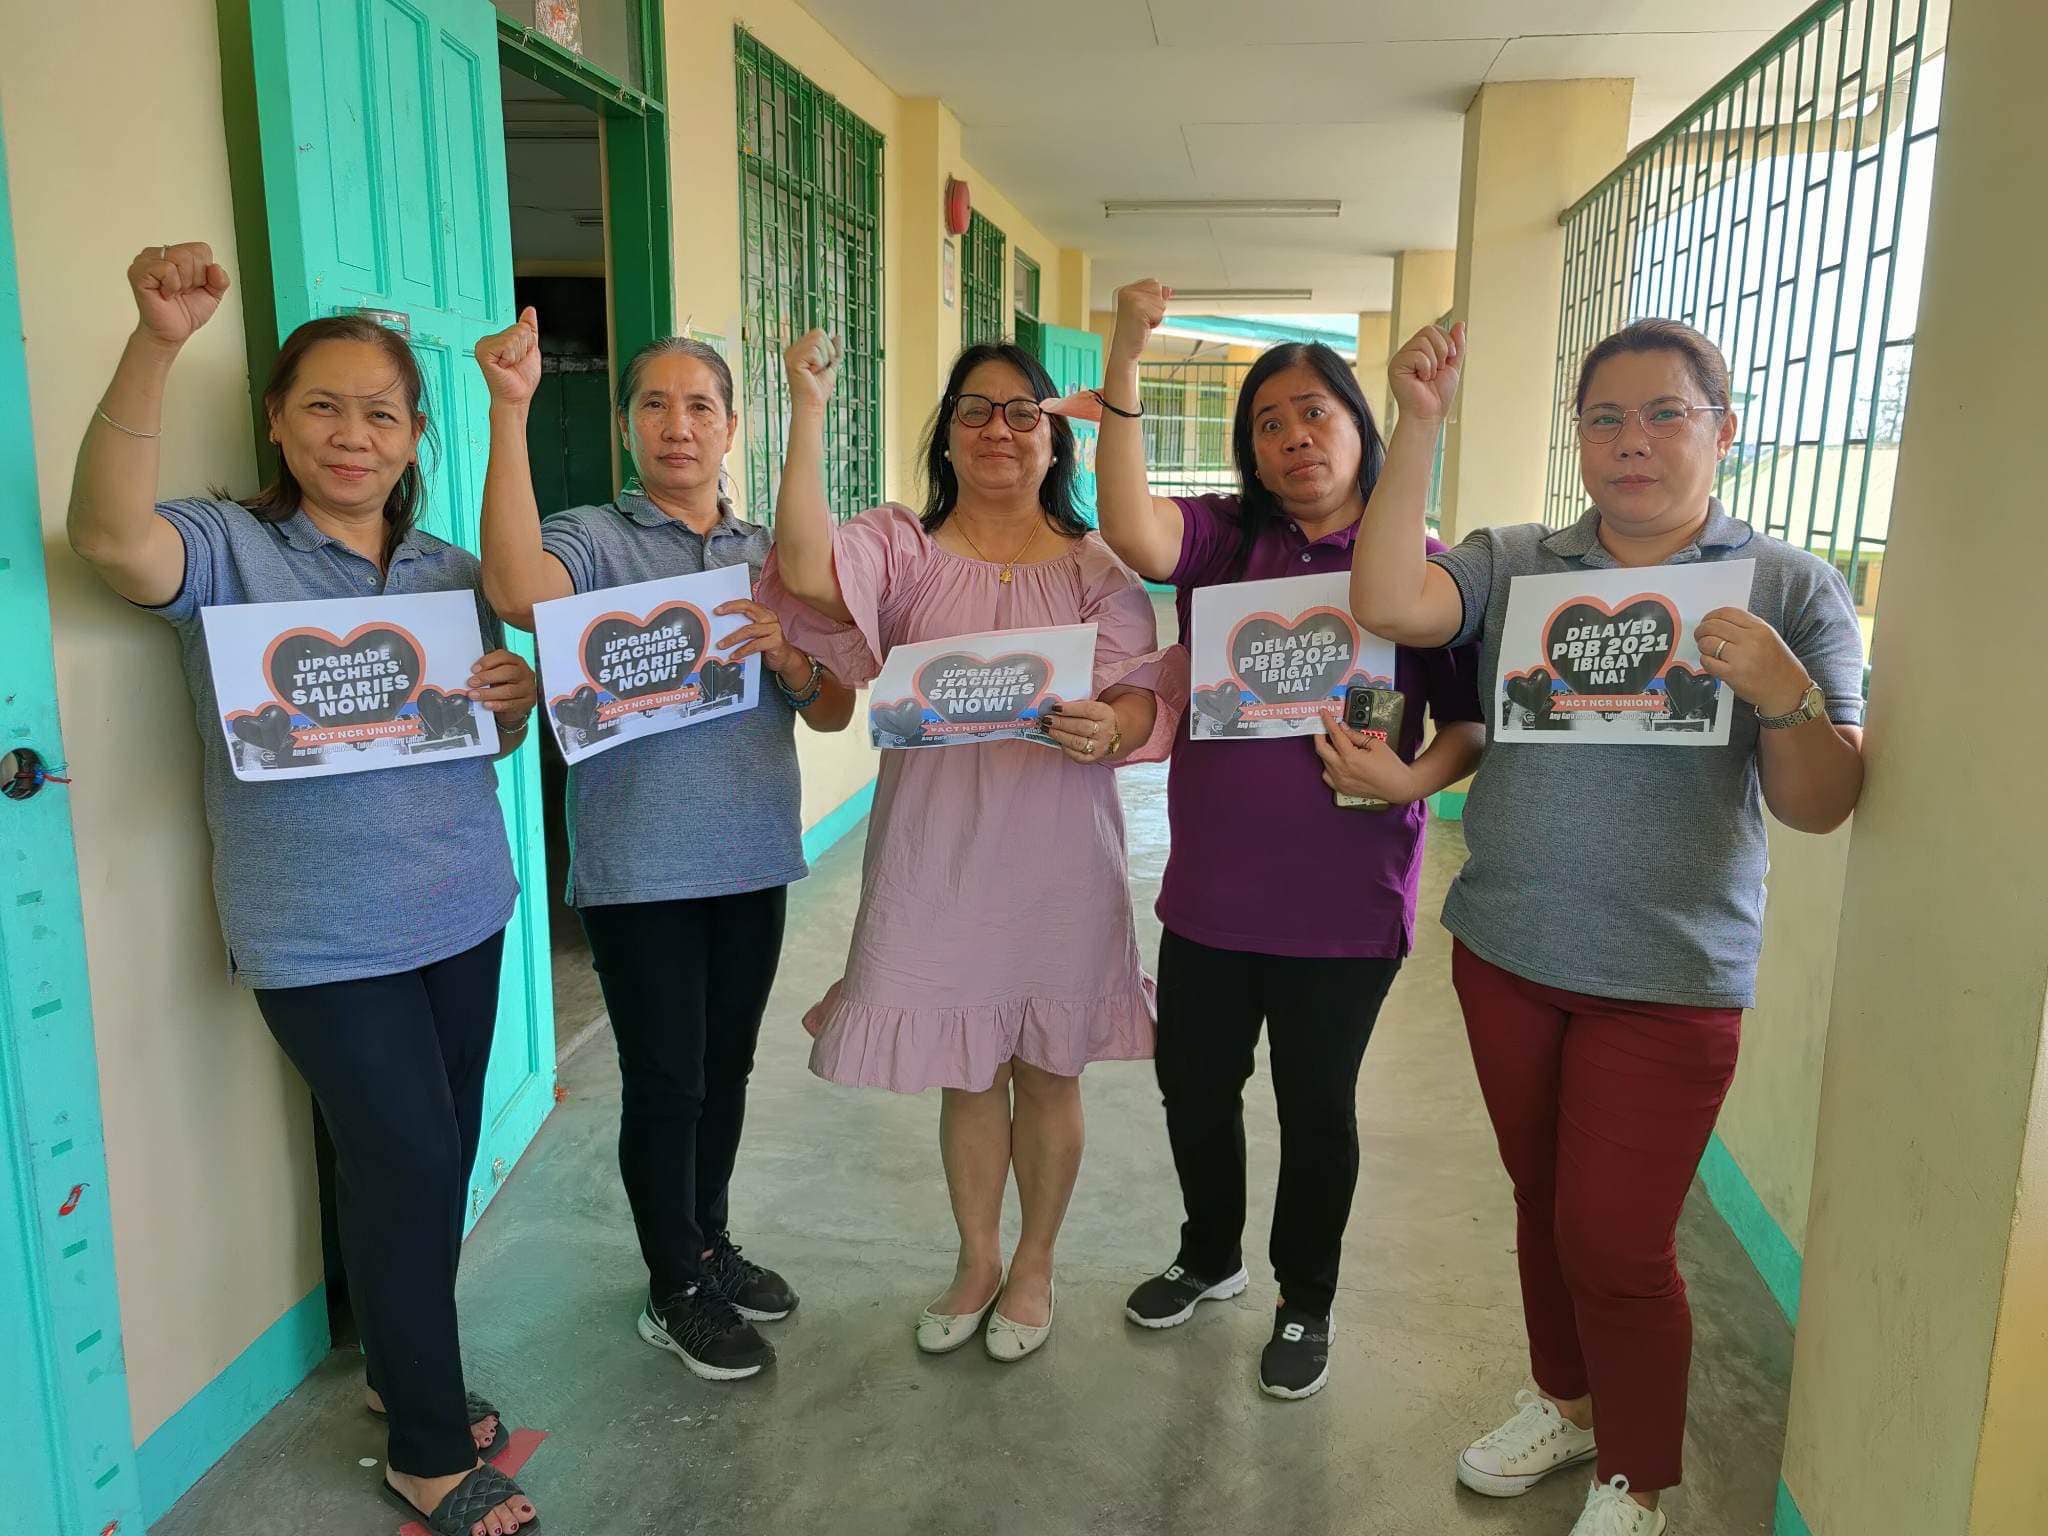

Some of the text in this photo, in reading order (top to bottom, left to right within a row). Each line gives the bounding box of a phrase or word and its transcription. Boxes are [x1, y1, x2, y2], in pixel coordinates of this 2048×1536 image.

[605, 625, 683, 653] UPGRADE
[1565, 619, 1657, 642] DELAYED
[1250, 631, 1336, 655] DELAYED
[1552, 633, 1669, 660] PBB 2021
[298, 647, 391, 672] UPGRADE
[599, 648, 696, 684] SALARIES
[1238, 644, 1350, 674] PBB 2021
[1573, 653, 1644, 672] IBIGAY
[619, 666, 678, 692] NOW!
[942, 666, 1026, 679] UPGRADE
[1261, 662, 1327, 683] IBIGAY
[1590, 670, 1626, 685] NA!
[292, 674, 410, 706] SALARIES
[928, 682, 1036, 701] SALARIES
[1277, 679, 1311, 695] NA!
[319, 694, 390, 718] NOW!
[610, 703, 630, 715] ACT
[632, 699, 654, 709] NCR
[656, 692, 689, 704] UNION
[948, 697, 1014, 715] NOW!
[1253, 709, 1273, 717] ACT
[1277, 708, 1297, 716] NCR
[1566, 699, 1653, 707] ACT NCR UNION
[310, 725, 405, 741] ACT NCR UNION
[988, 722, 1025, 730] UNION
